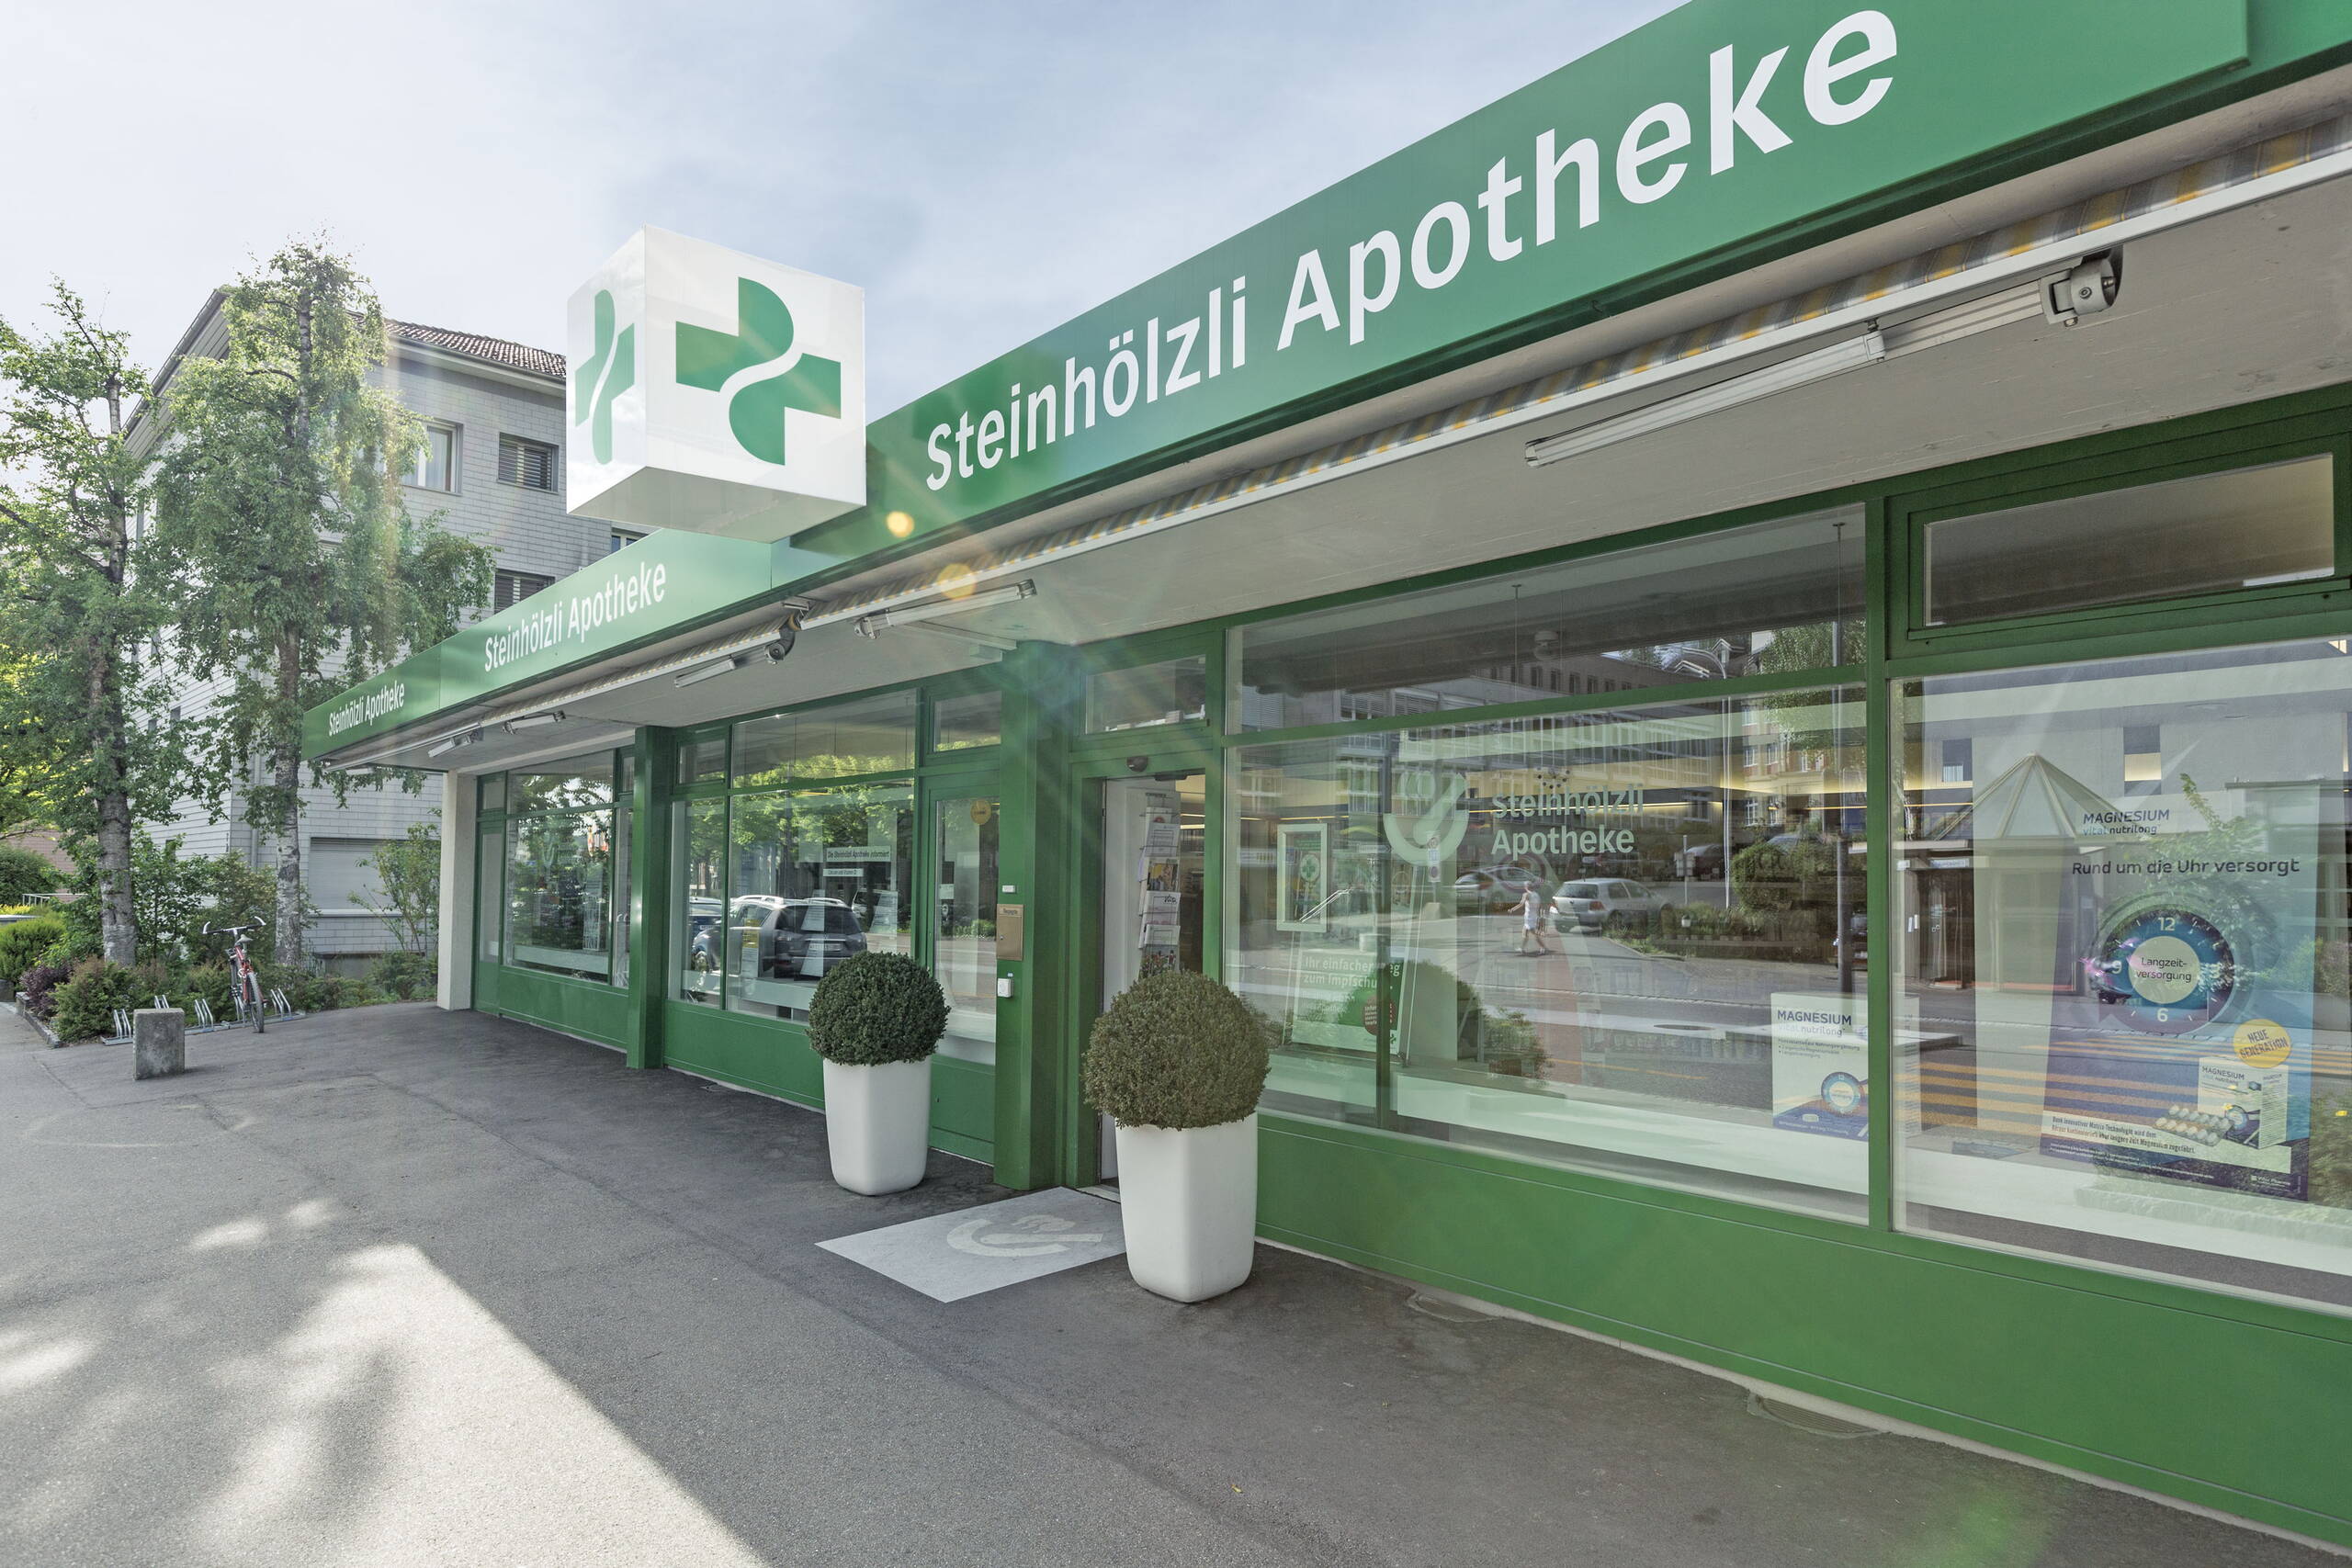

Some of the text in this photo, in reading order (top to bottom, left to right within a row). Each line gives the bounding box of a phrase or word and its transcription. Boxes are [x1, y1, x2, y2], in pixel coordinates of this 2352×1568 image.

[925, 8, 1898, 491] Steinhölzli Apotheke
[484, 561, 666, 672] Steinhölzli Apotheke
[328, 680, 405, 738] Steinhölzli Apotheke
[1491, 783, 1645, 819] Steinhölzli
[2083, 808, 2170, 824] MAGNESIUM
[2083, 824, 2107, 836] vital
[1491, 824, 1635, 861] Apotheke
[2072, 858, 2300, 876] Rund um die Uhr versorgt
[2157, 917, 2176, 931] 12
[1305, 956, 1319, 968] Ihr
[1322, 957, 1374, 971] einfacher
[2141, 957, 2188, 969] Langzeit-
[1303, 974, 1325, 985] zum
[2136, 969, 2192, 984] versorgung
[1777, 1010, 1852, 1026] MAGNESIUM
[2156, 1008, 2168, 1022] 6
[1801, 1025, 1843, 1038] nutrilong
[2247, 1029, 2270, 1043] NEUE
